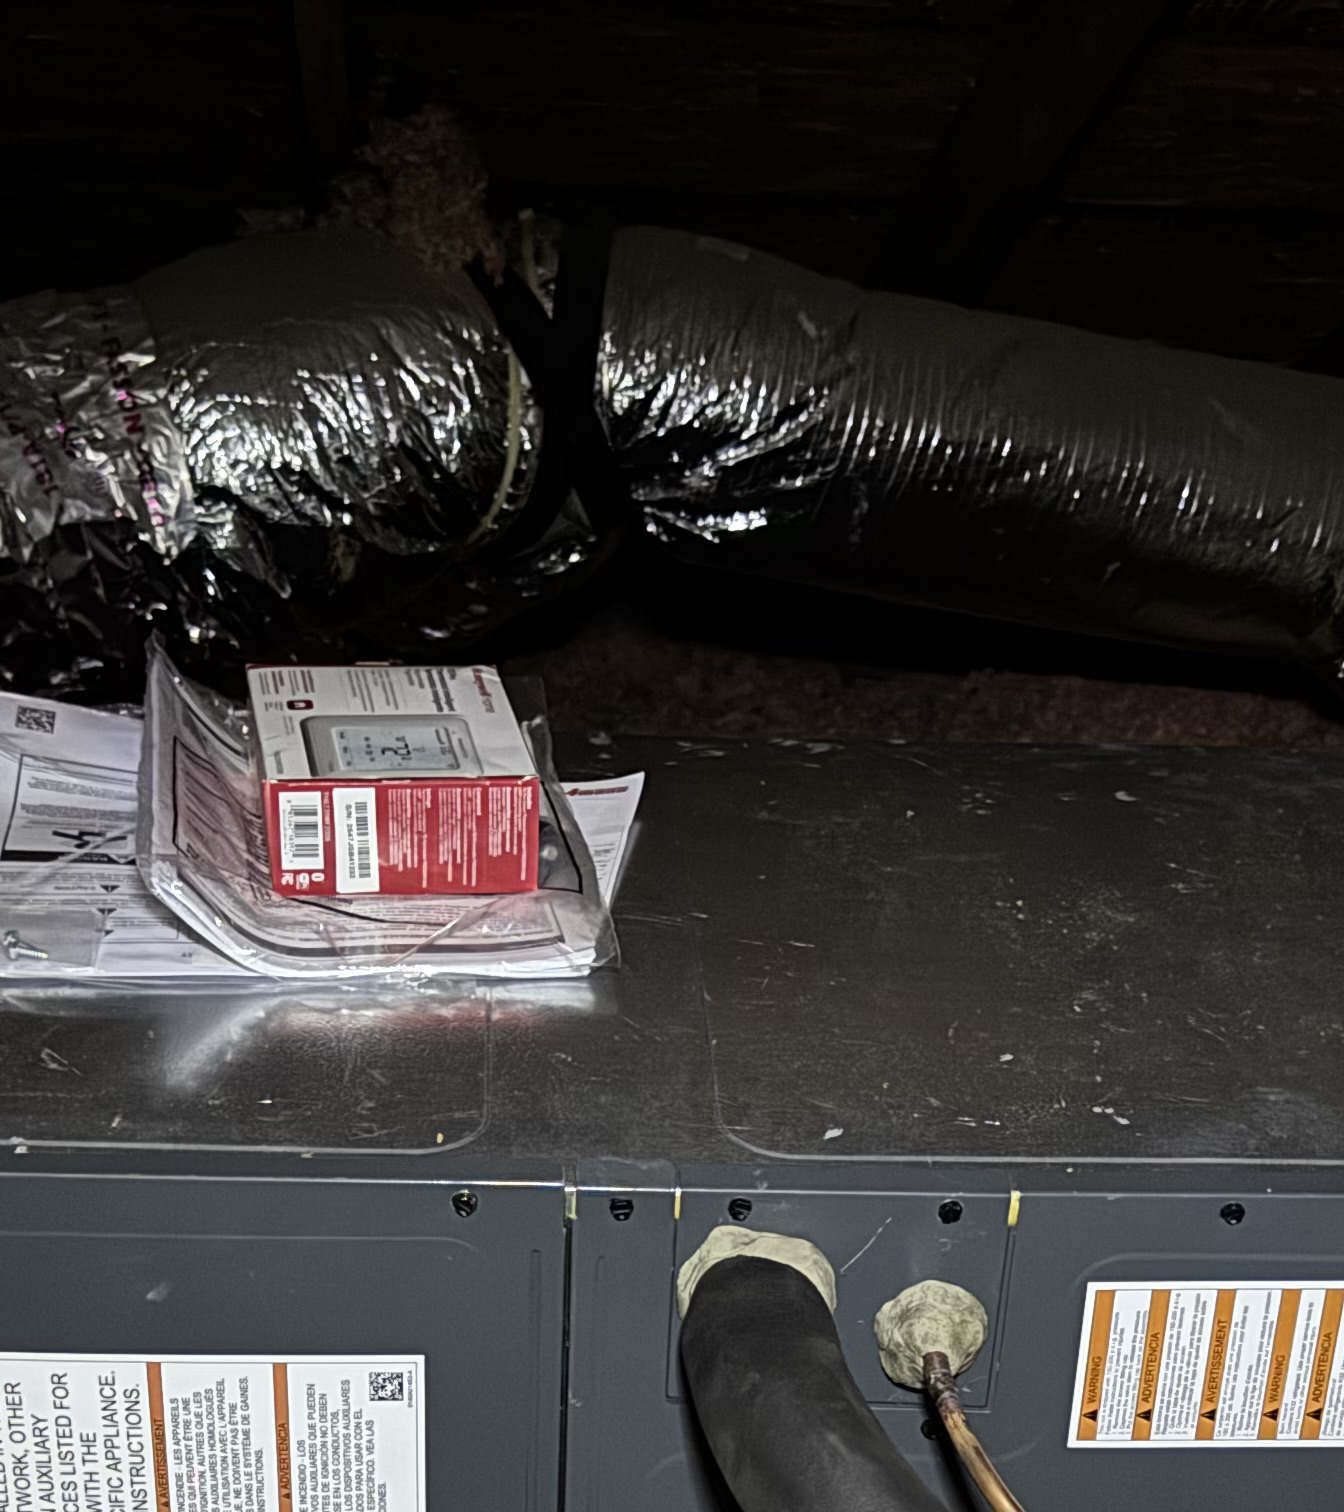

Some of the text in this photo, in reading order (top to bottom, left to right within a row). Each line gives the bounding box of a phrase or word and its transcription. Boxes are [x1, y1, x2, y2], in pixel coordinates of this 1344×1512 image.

[50, 1372, 70, 1409] FOR
[1086, 1355, 1102, 1403] WARNING
[1141, 1331, 1161, 1403] ADVERTENCIA
[1204, 1317, 1228, 1402] AVERTISSEMENT
[1268, 1354, 1285, 1402] WARNING
[1310, 1331, 1333, 1402] ADVERTENCIA
[3, 1382, 26, 1443] OTHER
[54, 1415, 76, 1475] LISTED
[97, 1370, 122, 1472] APPLIANCE.
[30, 1414, 55, 1503] AUXILIARY
[79, 1432, 98, 1466] THE
[153, 1416, 169, 1499] AVERTISSEMENT
[277, 1421, 290, 1490] ADVERTENCIA
